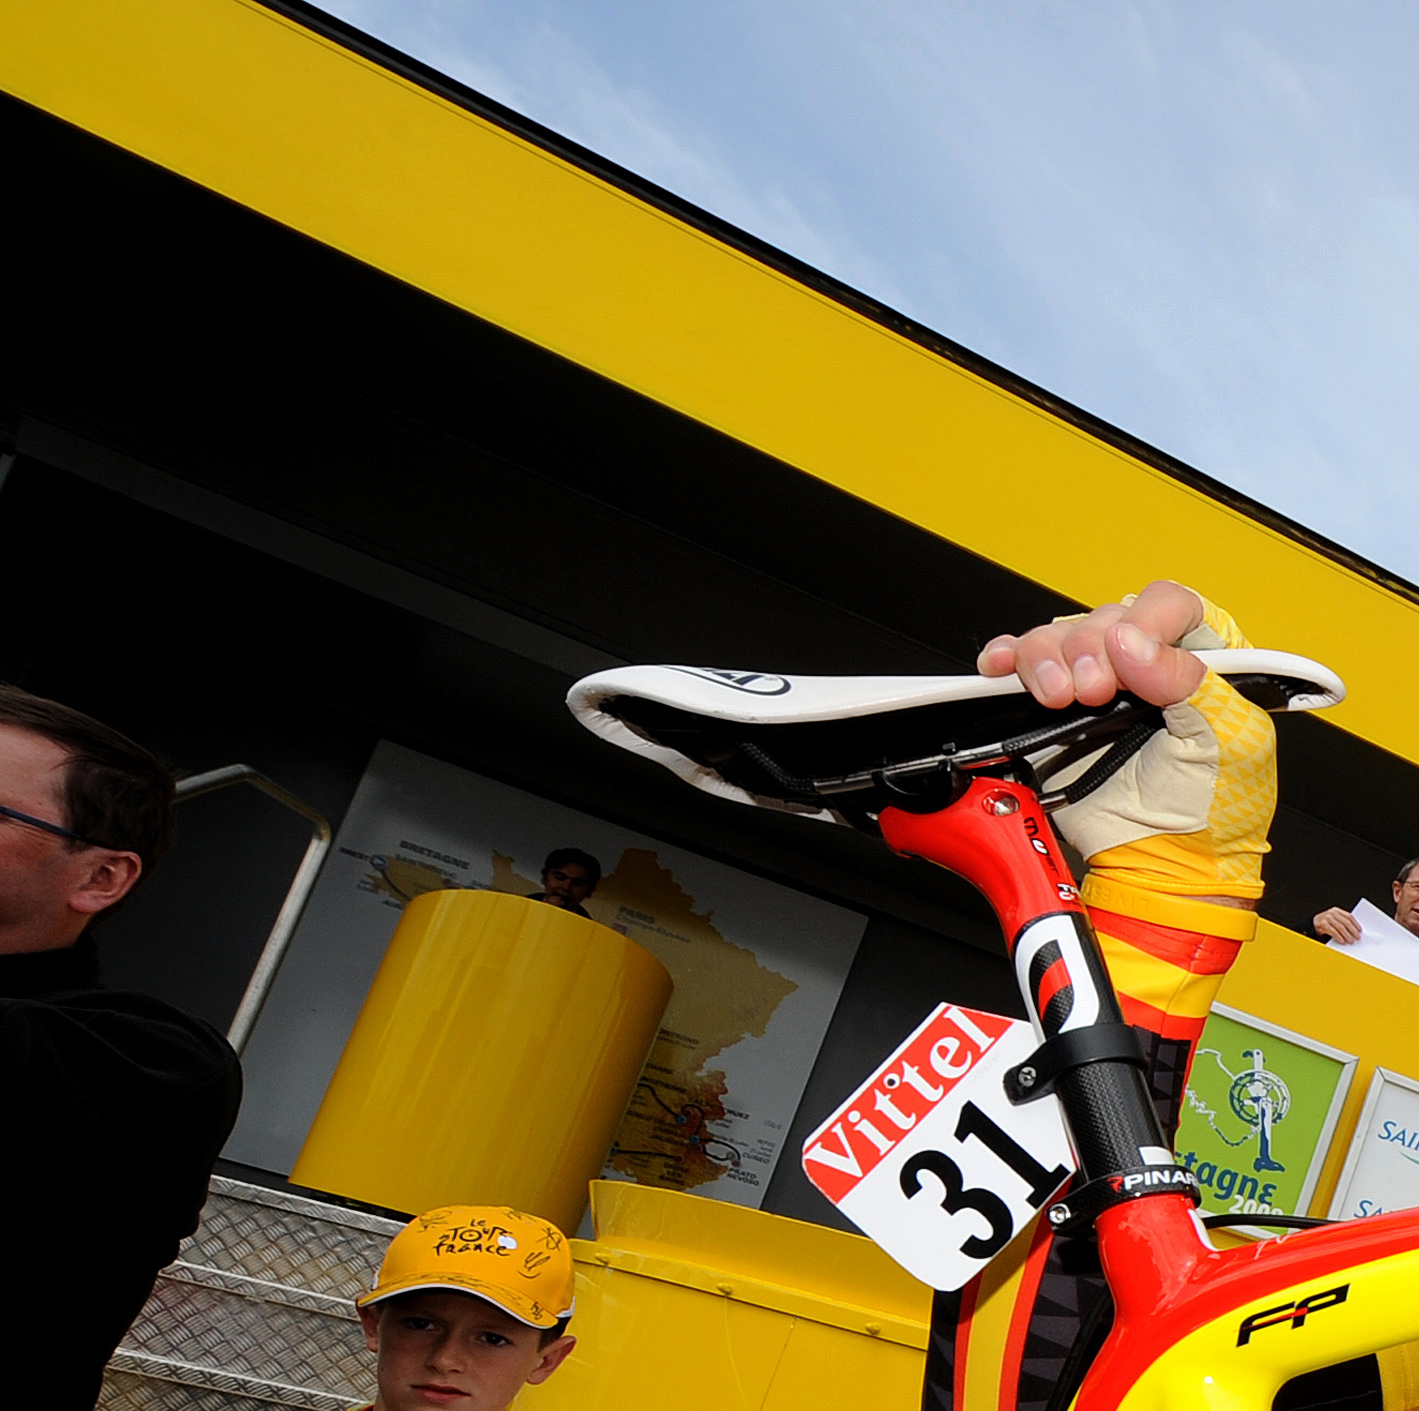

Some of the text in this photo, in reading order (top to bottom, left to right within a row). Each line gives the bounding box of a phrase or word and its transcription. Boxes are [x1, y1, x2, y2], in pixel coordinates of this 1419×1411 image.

[807, 1003, 1000, 1185] Vittel
[899, 1100, 1067, 1262] 31
[1180, 1151, 1278, 1207] tagne
